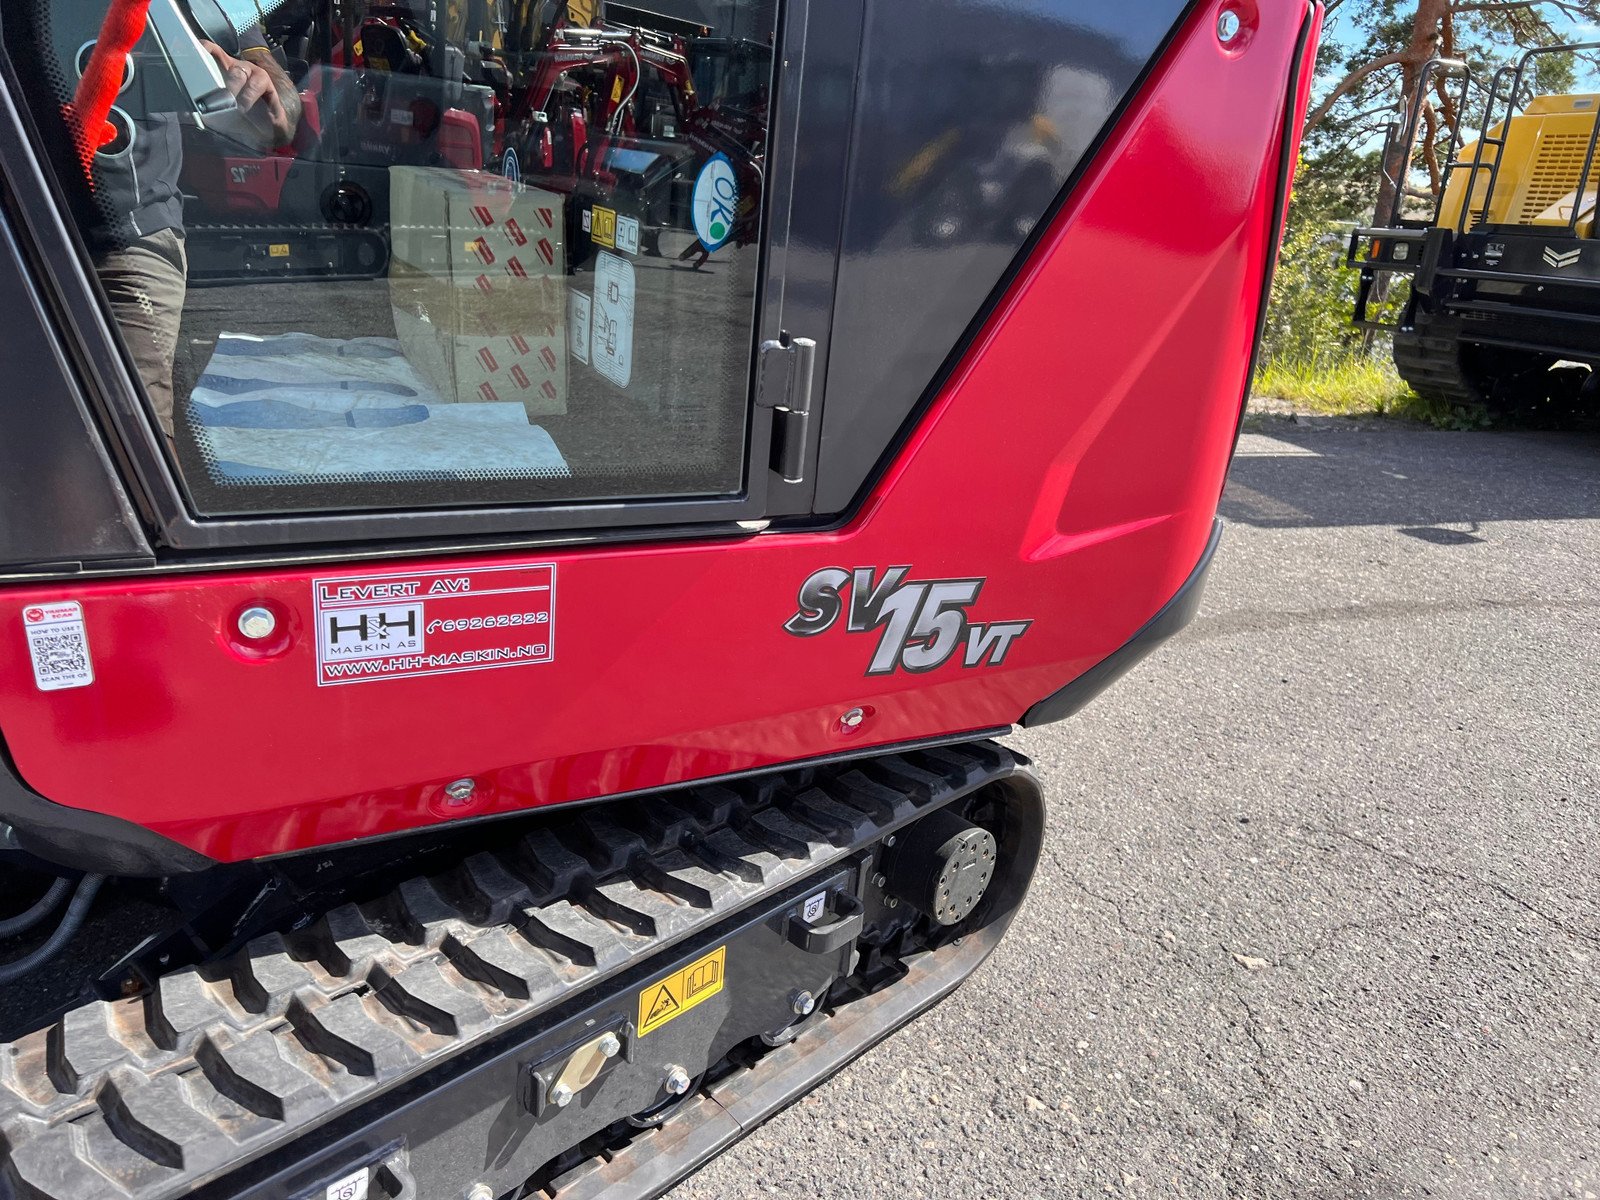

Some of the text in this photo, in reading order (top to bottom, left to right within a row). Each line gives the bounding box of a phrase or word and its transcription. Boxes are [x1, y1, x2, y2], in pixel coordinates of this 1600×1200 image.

[321, 577, 471, 602] LEVERT AV:
[330, 610, 416, 643] H&H
[443, 612, 549, 633] 69262222
[325, 643, 547, 677] WWW.HH-MASKIN.NO
[330, 640, 416, 655] MASKIN AS
